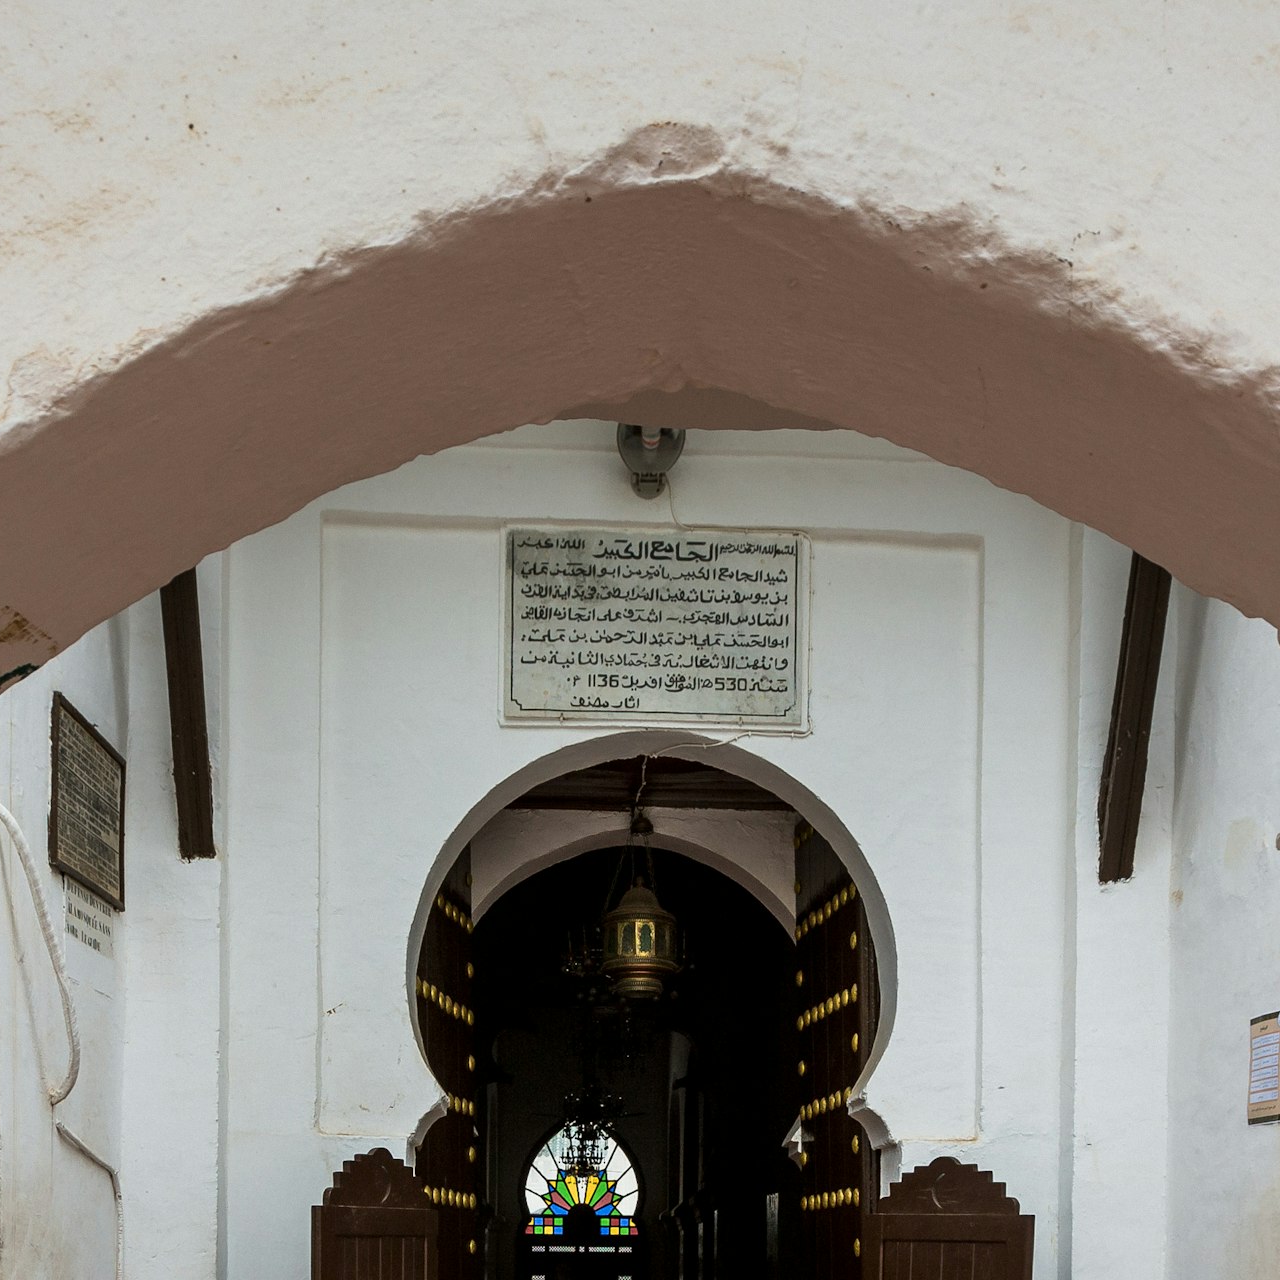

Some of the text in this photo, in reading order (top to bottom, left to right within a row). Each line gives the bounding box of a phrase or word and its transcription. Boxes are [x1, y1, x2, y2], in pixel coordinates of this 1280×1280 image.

[593, 540, 718, 562] الجامع الكبير
[549, 563, 596, 577] الحسن
[672, 566, 716, 581] الكبير
[718, 567, 762, 582] الجامع
[763, 569, 788, 585] شيد
[521, 584, 552, 598] القرن
[660, 588, 715, 603] تاشفين
[714, 589, 731, 604] بن
[731, 590, 769, 605] يوسف
[769, 592, 788, 605] بن
[730, 613, 789, 626] السادس
[569, 630, 587, 643] بن
[649, 632, 674, 646] عبد
[724, 634, 770, 648] الحسن
[521, 651, 546, 664] من
[548, 651, 603, 668] الثانية
[588, 674, 619, 688] 1136
[715, 677, 747, 691] 530
[749, 678, 788, 692] سنة
